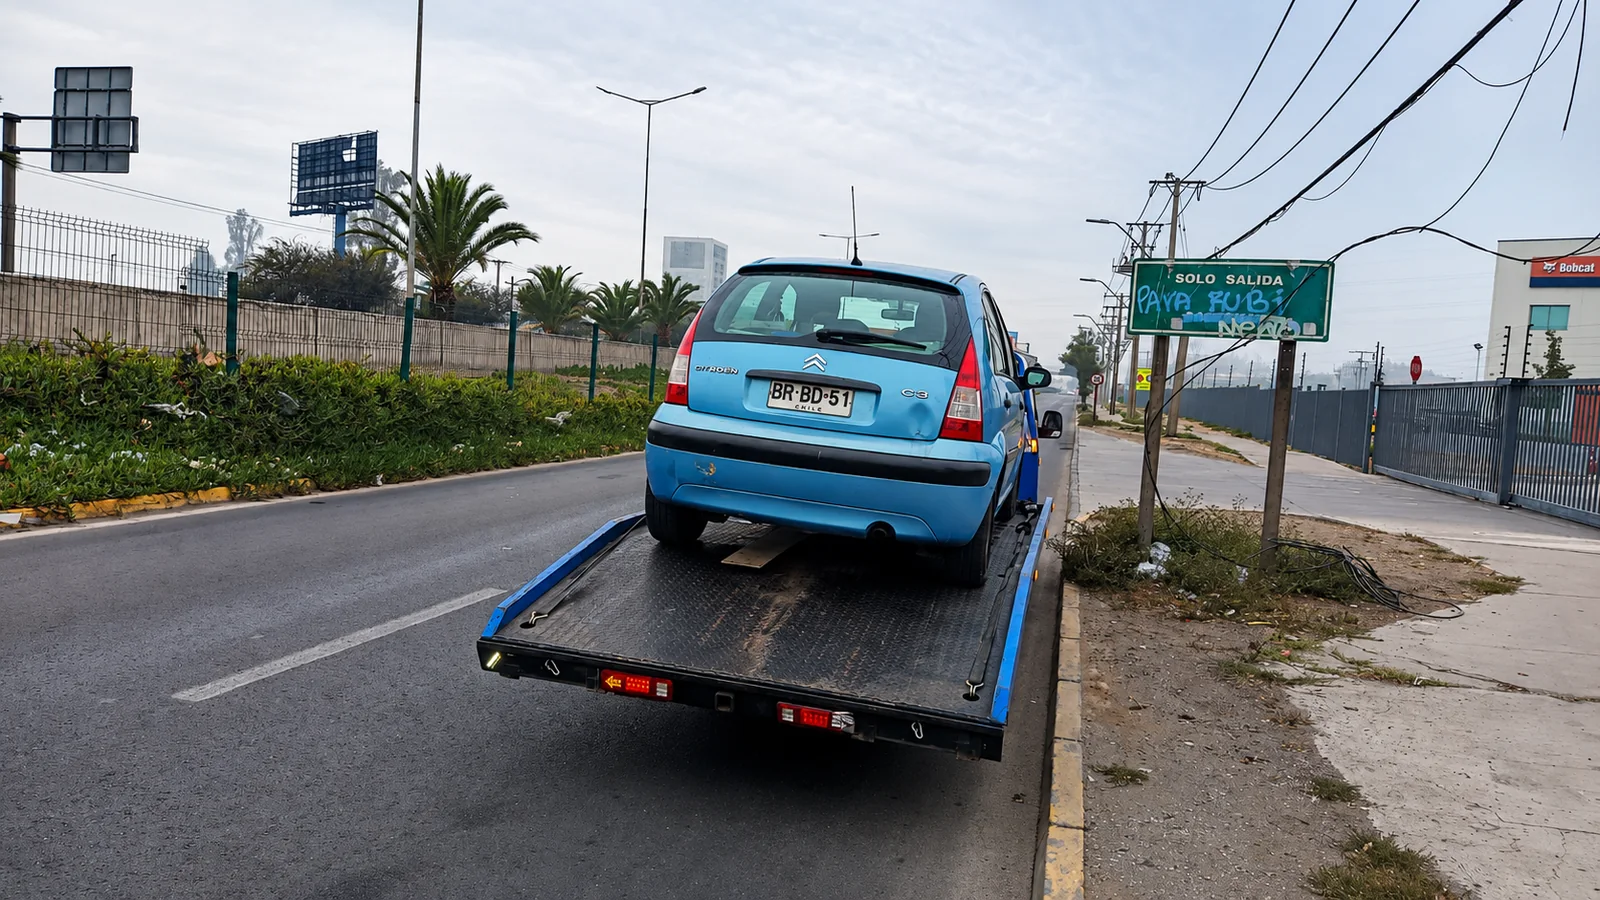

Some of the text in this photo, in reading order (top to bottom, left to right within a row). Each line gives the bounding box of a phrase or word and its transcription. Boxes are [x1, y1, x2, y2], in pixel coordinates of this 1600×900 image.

[1559, 262, 1595, 274] Bobcat
[1175, 273, 1284, 286] SOLO SALIDA
[900, 387, 929, 400] C3
